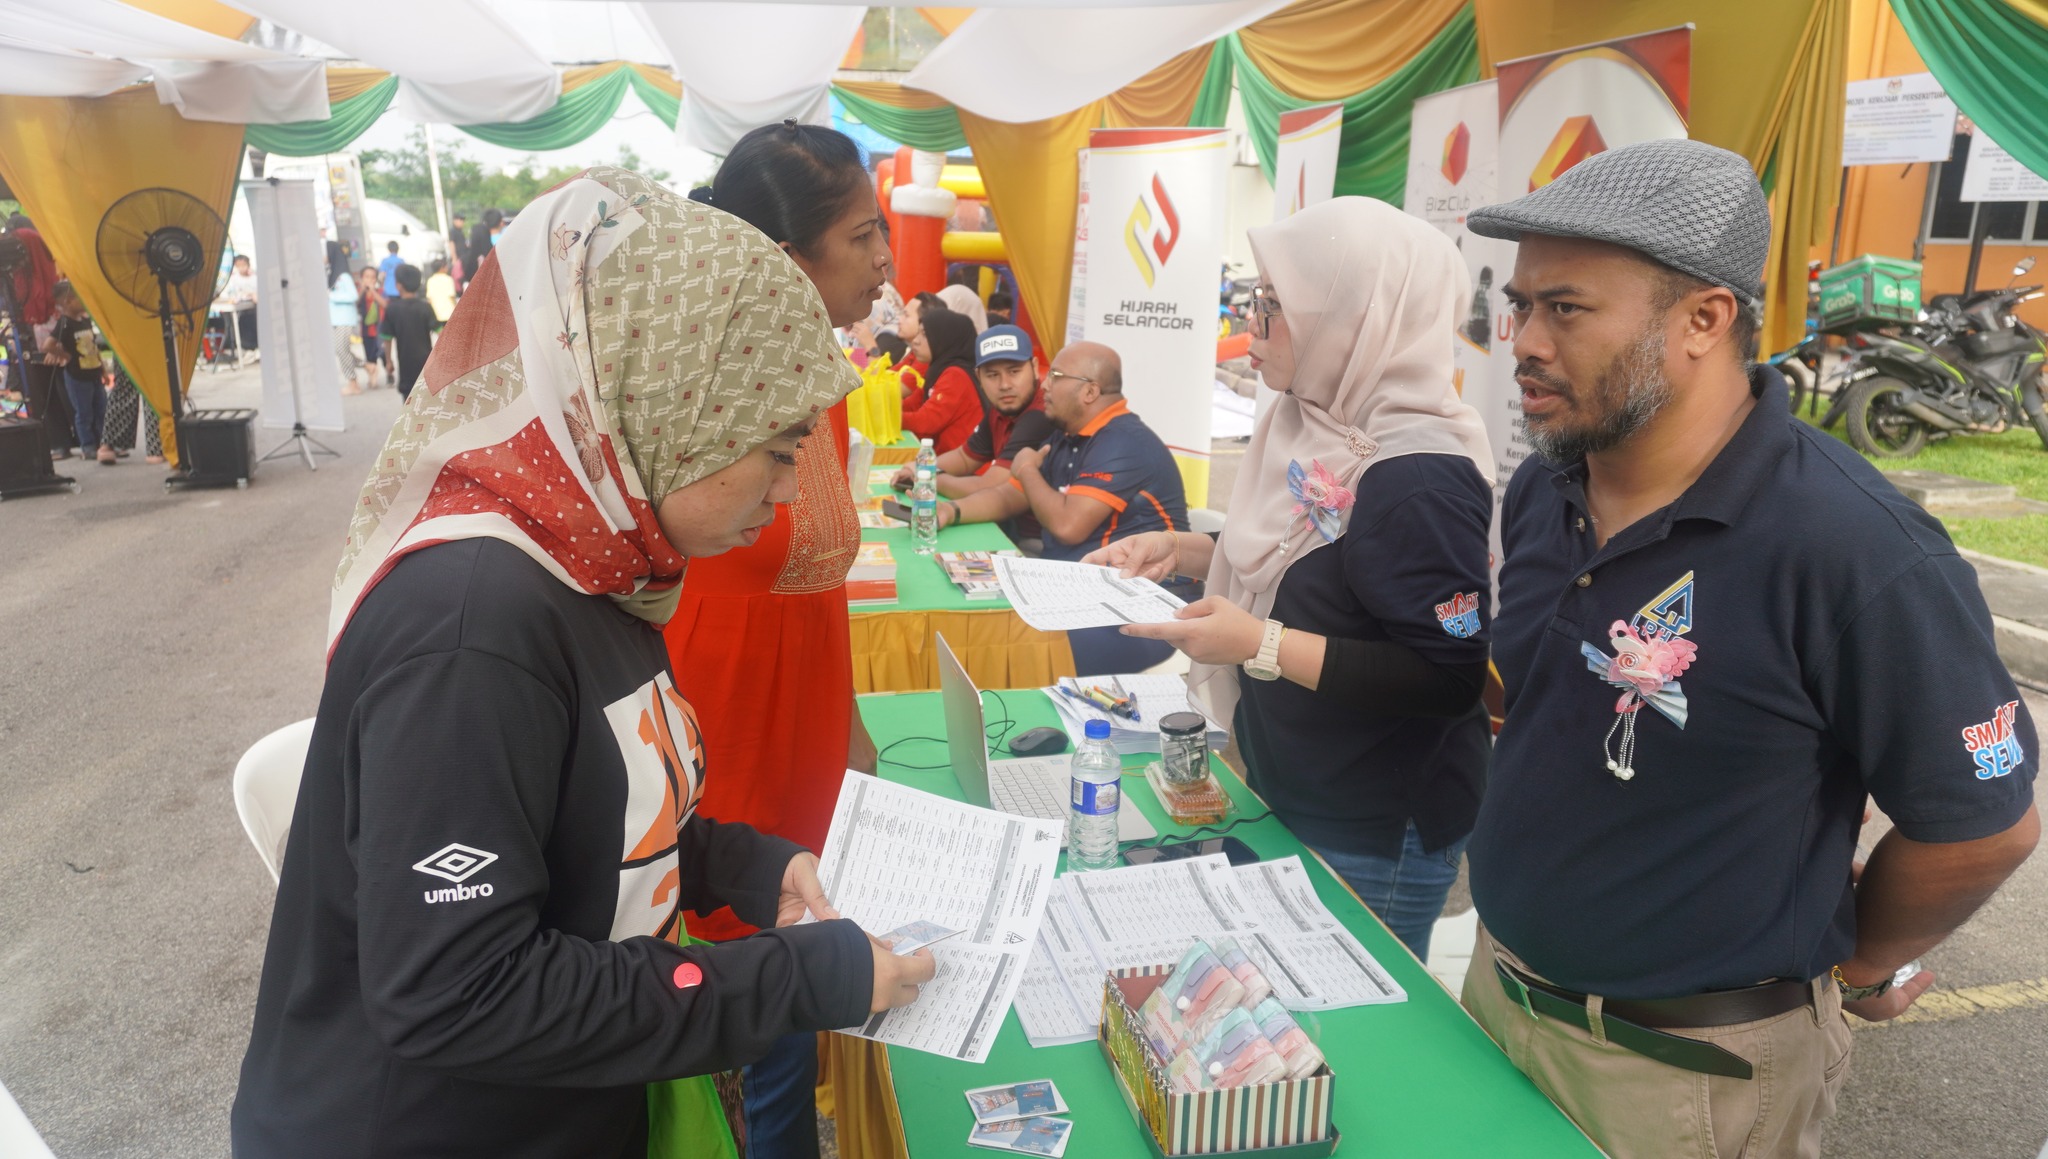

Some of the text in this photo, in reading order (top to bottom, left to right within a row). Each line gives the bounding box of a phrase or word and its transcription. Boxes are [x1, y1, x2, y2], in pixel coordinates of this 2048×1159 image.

[1426, 196, 1470, 212] BizClub
[1825, 291, 1857, 313] Grab
[1883, 284, 1915, 302] Grab
[1120, 300, 1177, 315] HIJRAH
[1103, 314, 1193, 330] SELANGOR
[983, 338, 1014, 352] PING
[1435, 592, 1479, 621] SMART
[1443, 609, 1482, 638] SEWA
[425, 882, 494, 905] umbro
